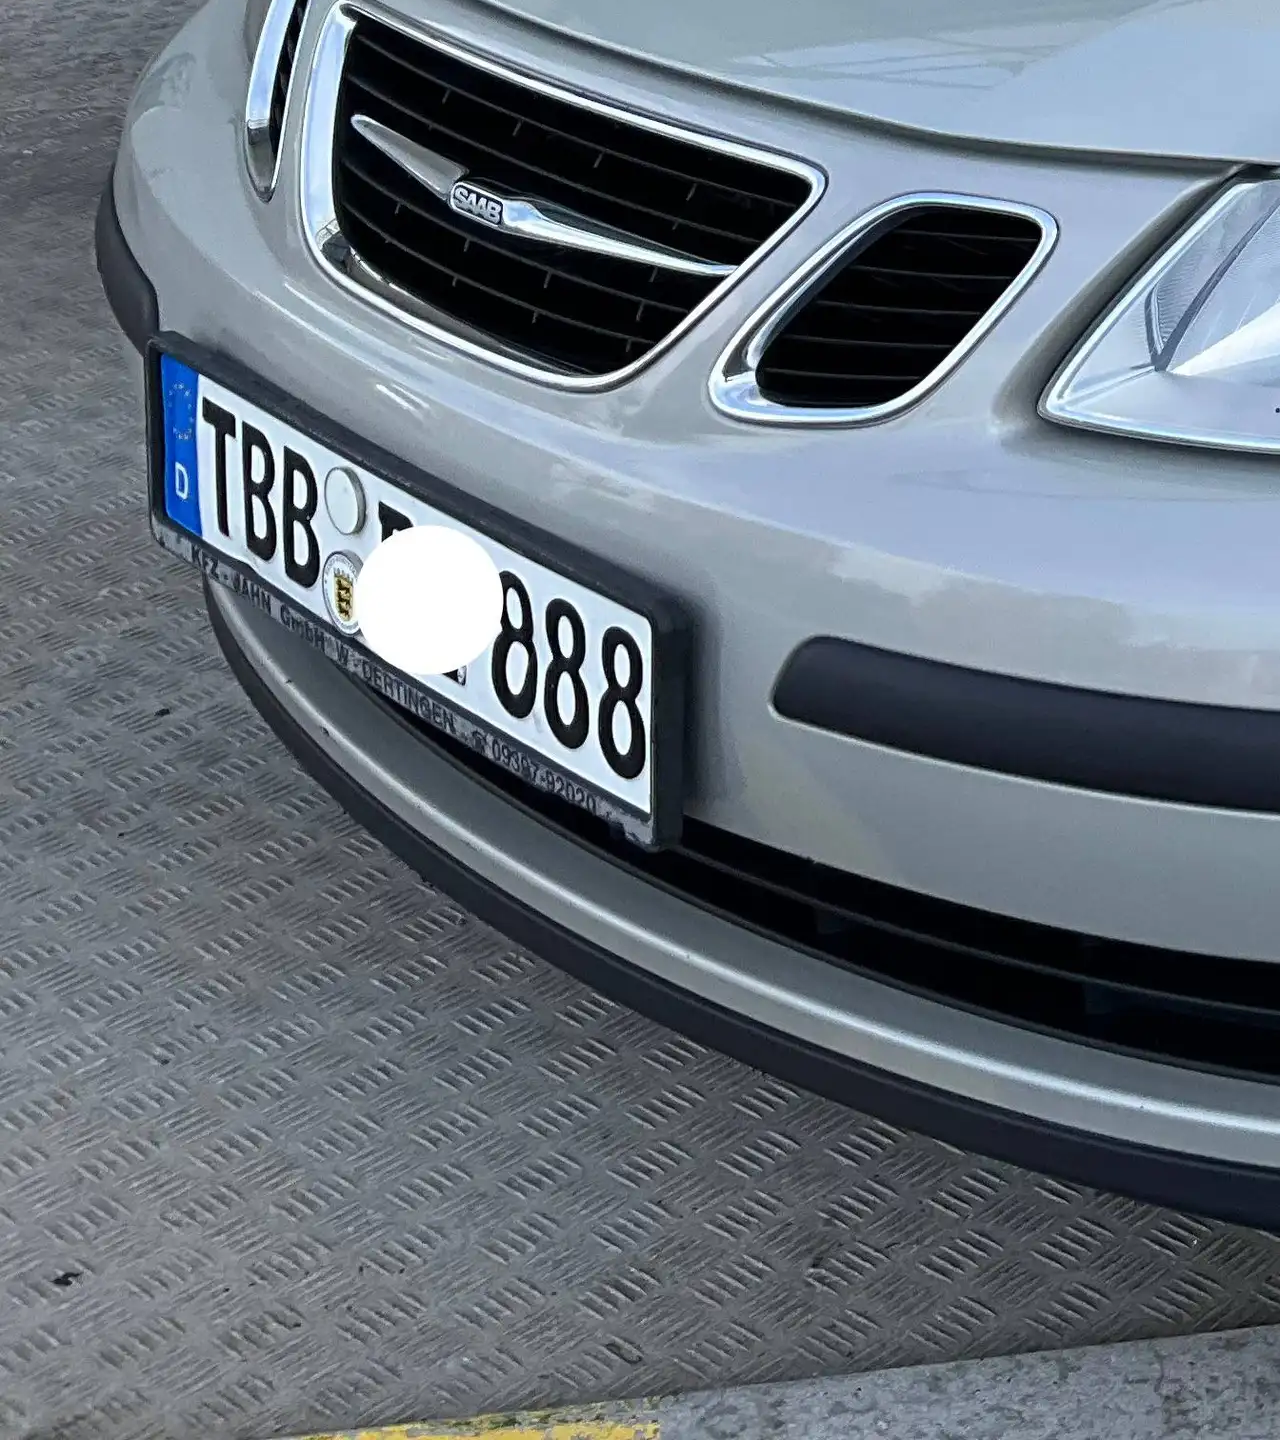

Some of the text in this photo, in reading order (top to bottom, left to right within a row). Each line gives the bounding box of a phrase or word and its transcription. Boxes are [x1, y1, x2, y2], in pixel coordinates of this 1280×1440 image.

[454, 186, 502, 224] SAAB
[174, 461, 189, 501] D
[202, 396, 321, 589] TBB
[491, 570, 646, 780] 888
